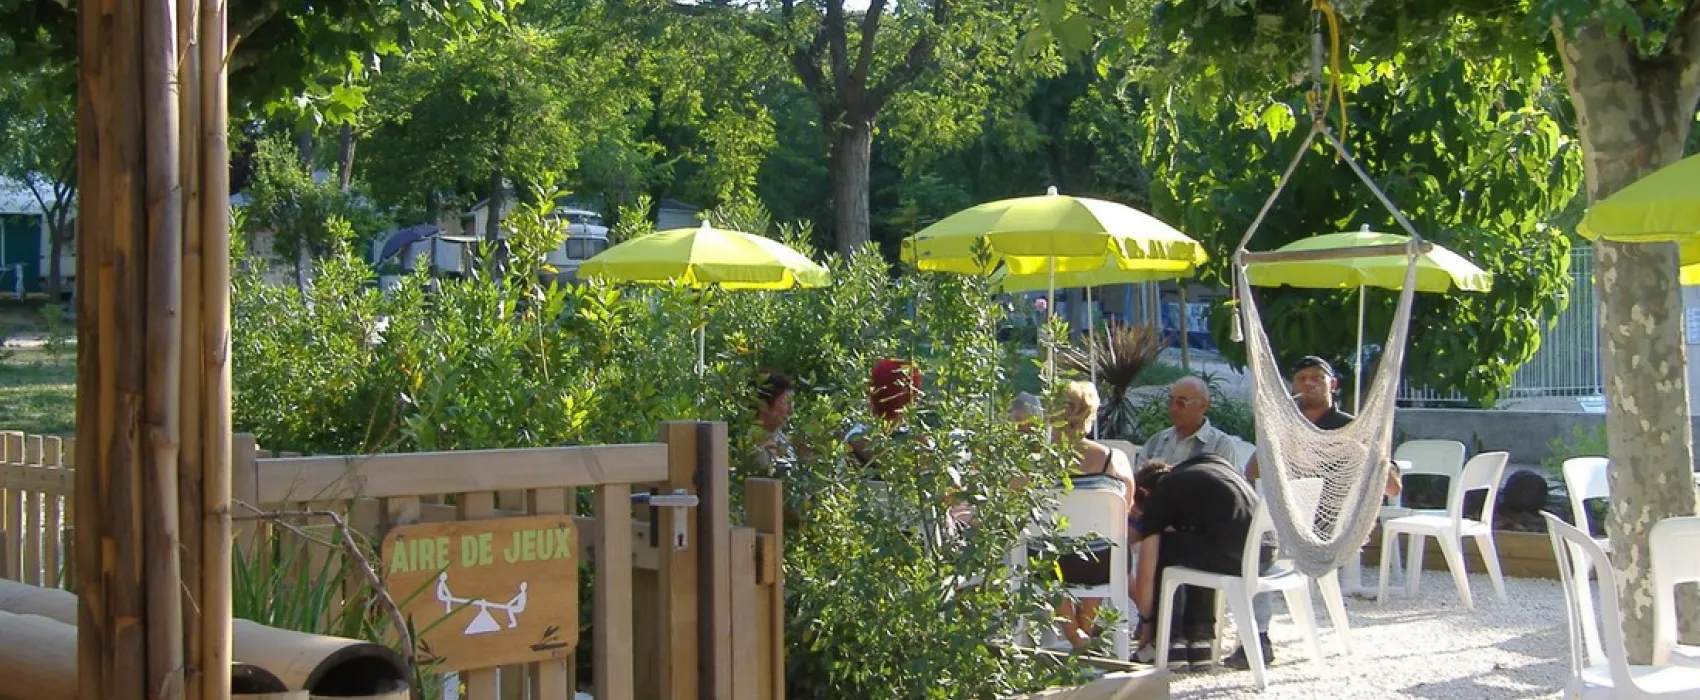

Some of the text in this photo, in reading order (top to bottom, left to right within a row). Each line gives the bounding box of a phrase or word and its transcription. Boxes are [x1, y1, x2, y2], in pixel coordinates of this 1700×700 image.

[391, 528, 571, 573] AIRE DE JEUX
